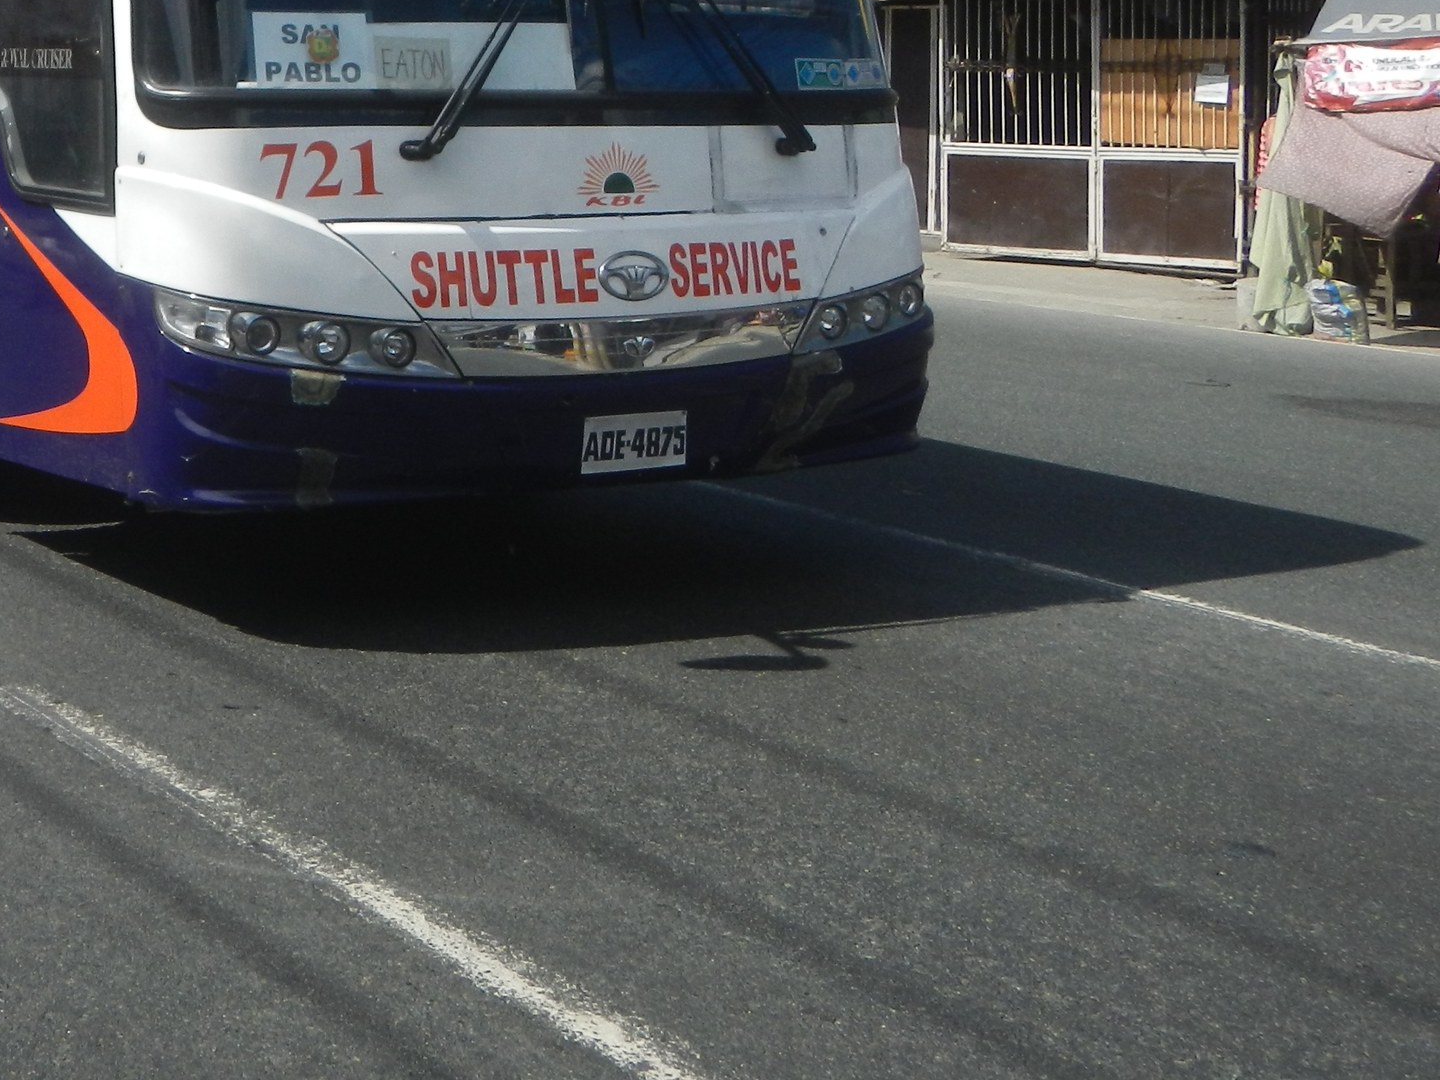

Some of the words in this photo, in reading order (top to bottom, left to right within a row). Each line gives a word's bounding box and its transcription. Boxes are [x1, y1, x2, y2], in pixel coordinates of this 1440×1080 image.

[31, 48, 73, 69] CRUISER
[265, 62, 362, 83] PABLO
[381, 48, 446, 80] EATON
[260, 139, 383, 199] 721
[585, 194, 646, 207] KBL
[410, 248, 599, 309] SHUTTLE
[669, 239, 801, 298] SERVICE
[582, 425, 686, 462] ADE-4875
